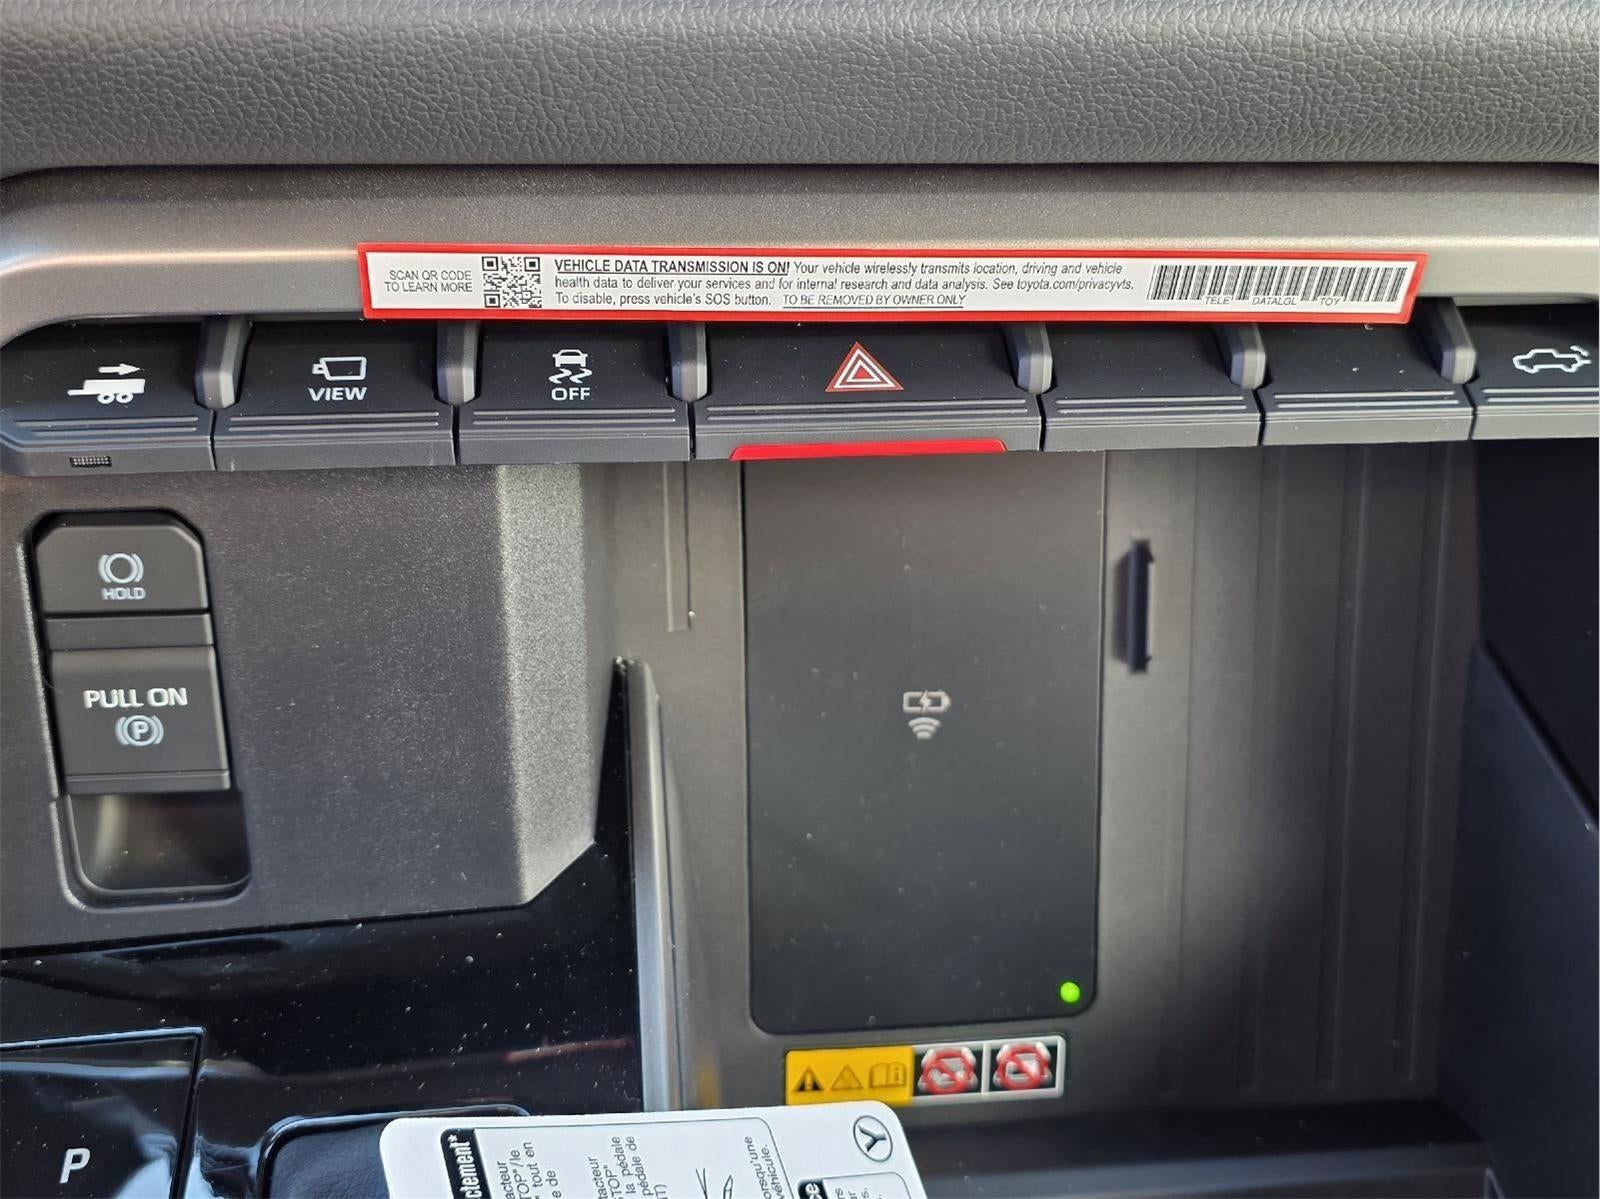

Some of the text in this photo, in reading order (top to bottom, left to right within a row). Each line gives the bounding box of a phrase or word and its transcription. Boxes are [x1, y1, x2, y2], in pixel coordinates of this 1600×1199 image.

[389, 270, 472, 281] SCAN QR CODE
[554, 259, 1122, 277] VEHICLE DATA TRANSMISSION IS ON! Your vehicle wirelessly transmits location, driving and vehicle
[384, 281, 473, 293] TO LEARN MORE
[555, 276, 1134, 293] health data to deliver your services and for internal research and data analysis. See toyota.com/privacyvts.
[555, 292, 966, 307] To disable, press vehicle's SOS button. TO BE REMOVED BY OWNER ONLY
[1204, 296, 1341, 306] TELE DATALGL TOY
[308, 386, 367, 401] VIEW
[551, 387, 591, 401] OFF
[102, 587, 146, 600] HOLD
[83, 688, 188, 708] PULL ON
[131, 721, 149, 740] P
[858, 1125, 886, 1152] Y
[523, 1142, 535, 1157] en
[59, 1147, 90, 1184] P
[611, 1136, 636, 1193] la pédale
[625, 1136, 654, 1196] pédale de
[527, 1162, 543, 1187] tout
[546, 1170, 558, 1186] de
